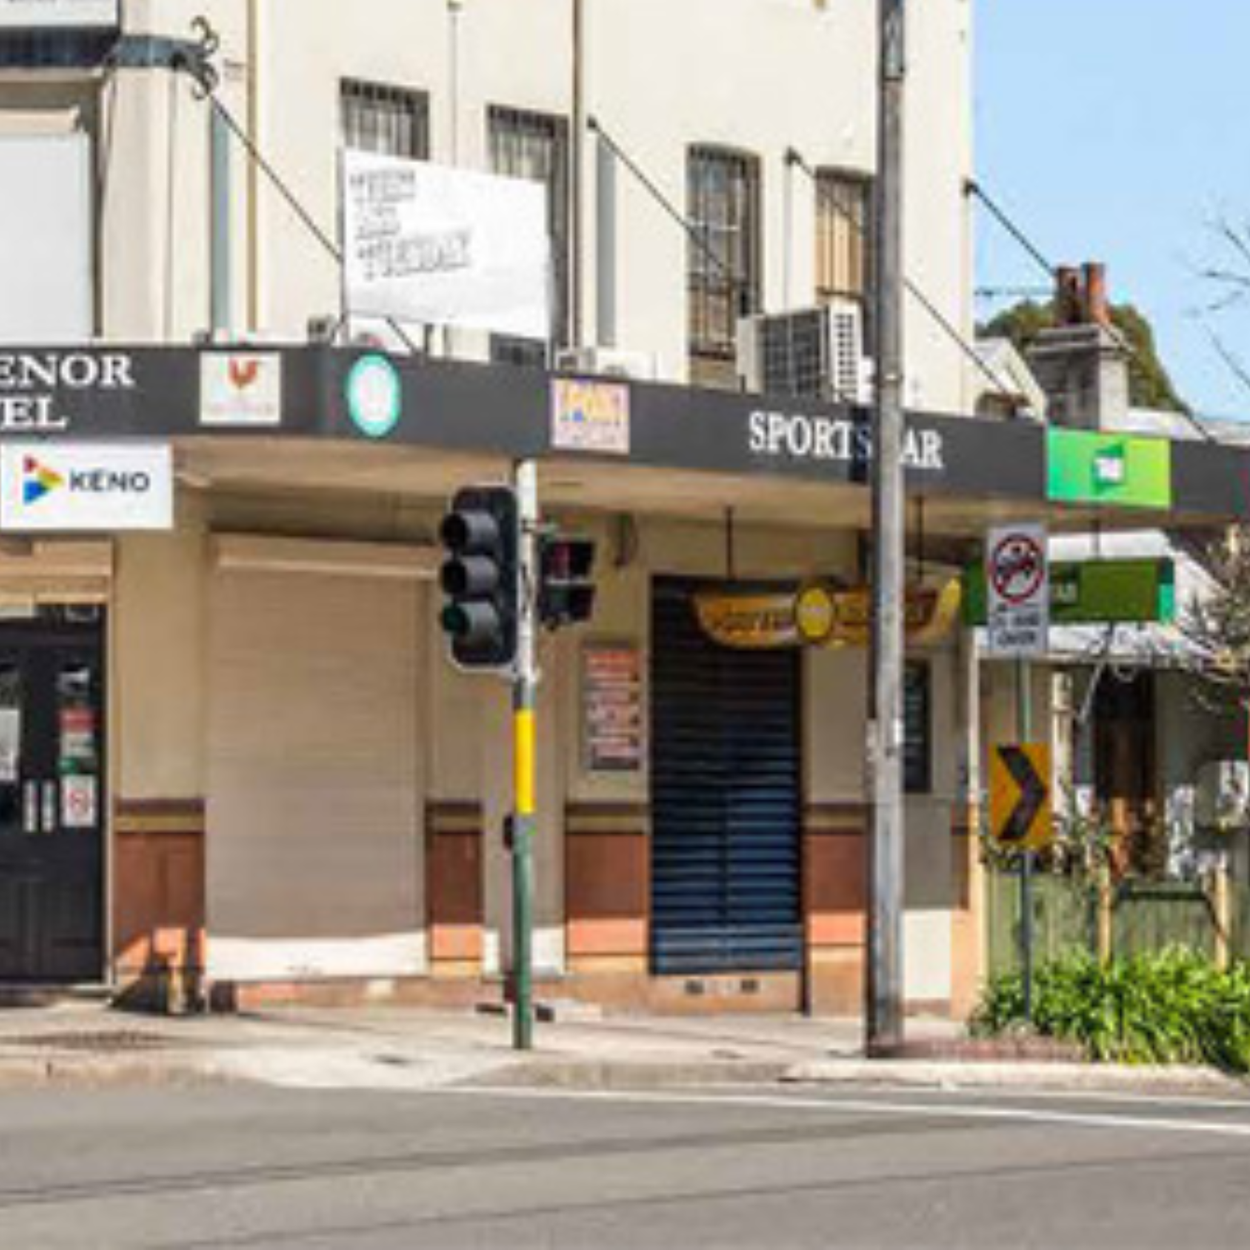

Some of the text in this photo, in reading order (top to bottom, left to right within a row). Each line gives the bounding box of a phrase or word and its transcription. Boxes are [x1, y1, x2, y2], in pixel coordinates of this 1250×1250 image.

[749, 410, 944, 470] SPORTS AR
[69, 468, 151, 493] KENO
